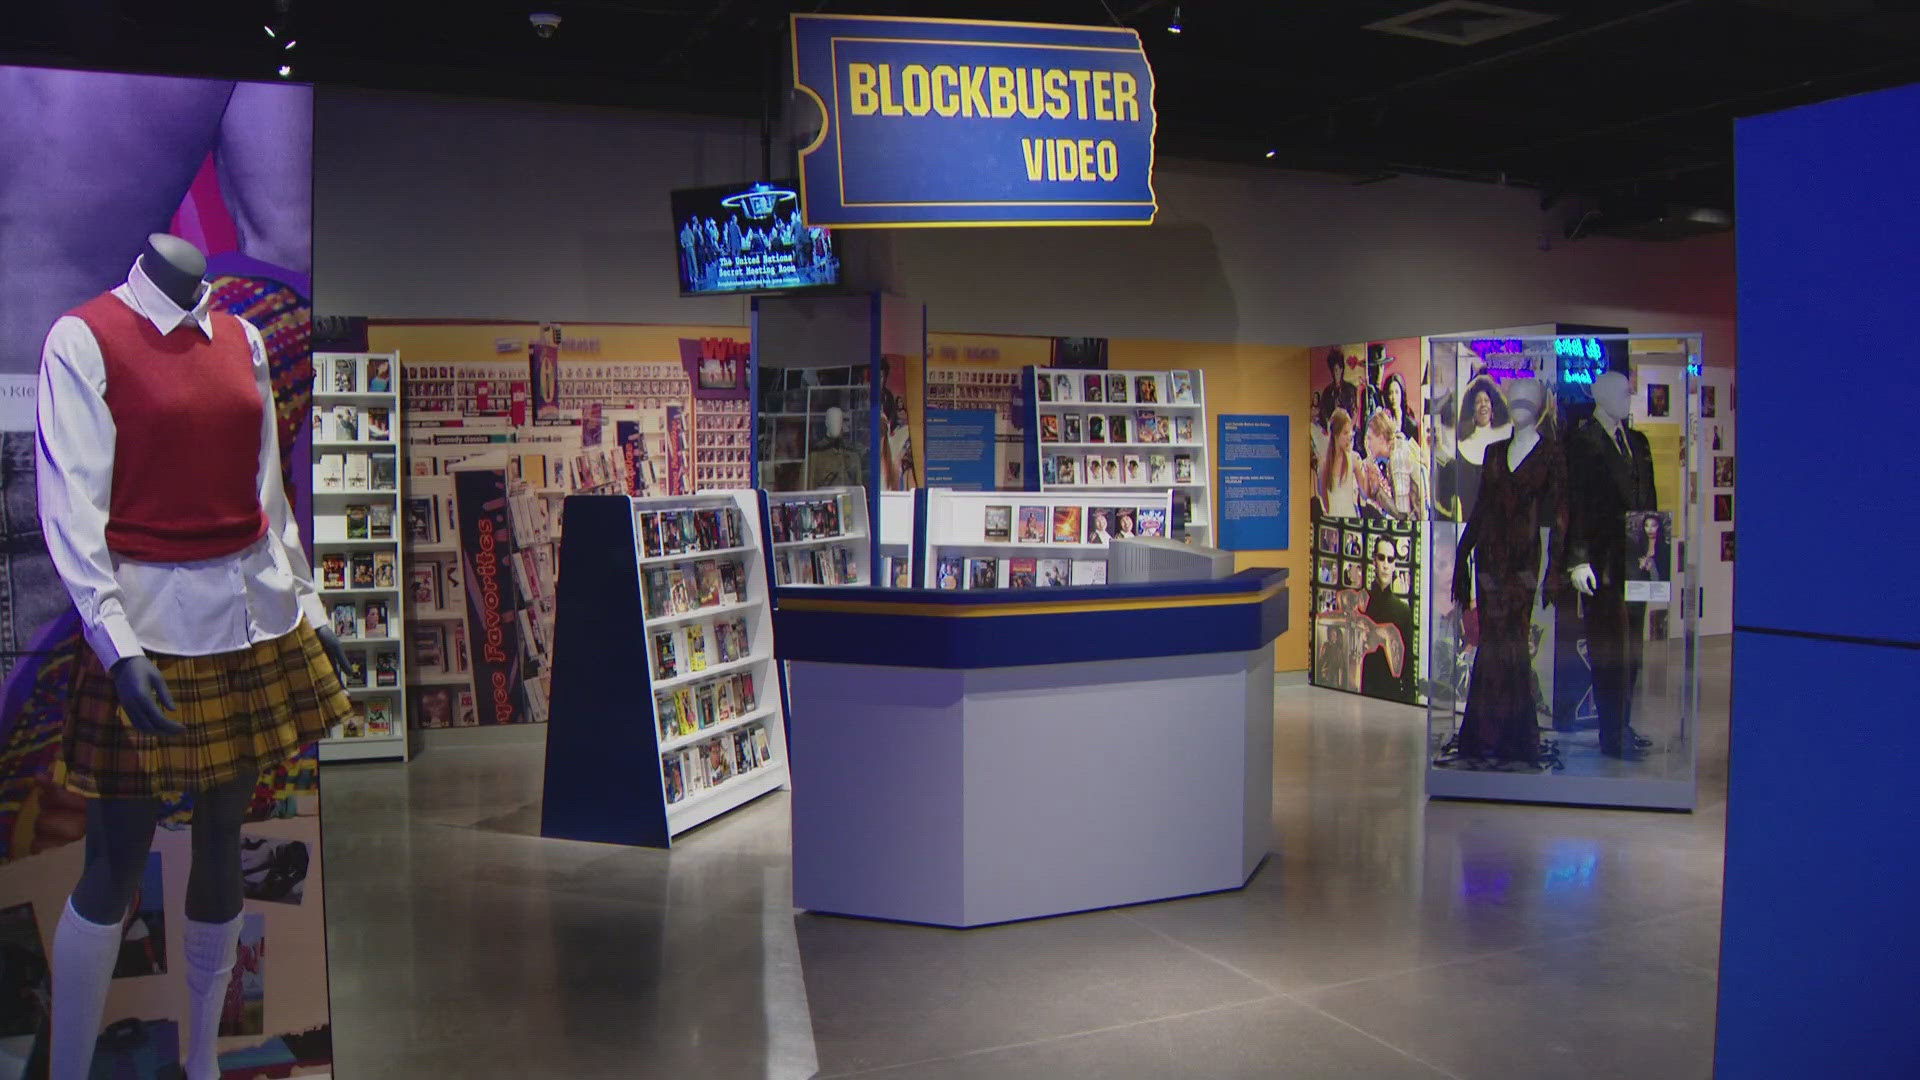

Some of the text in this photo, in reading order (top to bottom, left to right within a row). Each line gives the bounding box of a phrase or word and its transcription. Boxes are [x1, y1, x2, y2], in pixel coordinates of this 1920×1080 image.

[849, 63, 1140, 121] BLOCKBUSTER
[1022, 138, 1119, 182] VIDEO
[719, 257, 732, 266] The
[735, 254, 760, 266] United
[719, 262, 796, 277] Secret Meeting Room
[436, 435, 462, 445] comedy
[464, 434, 489, 444] classics
[476, 518, 506, 663] Favorites
